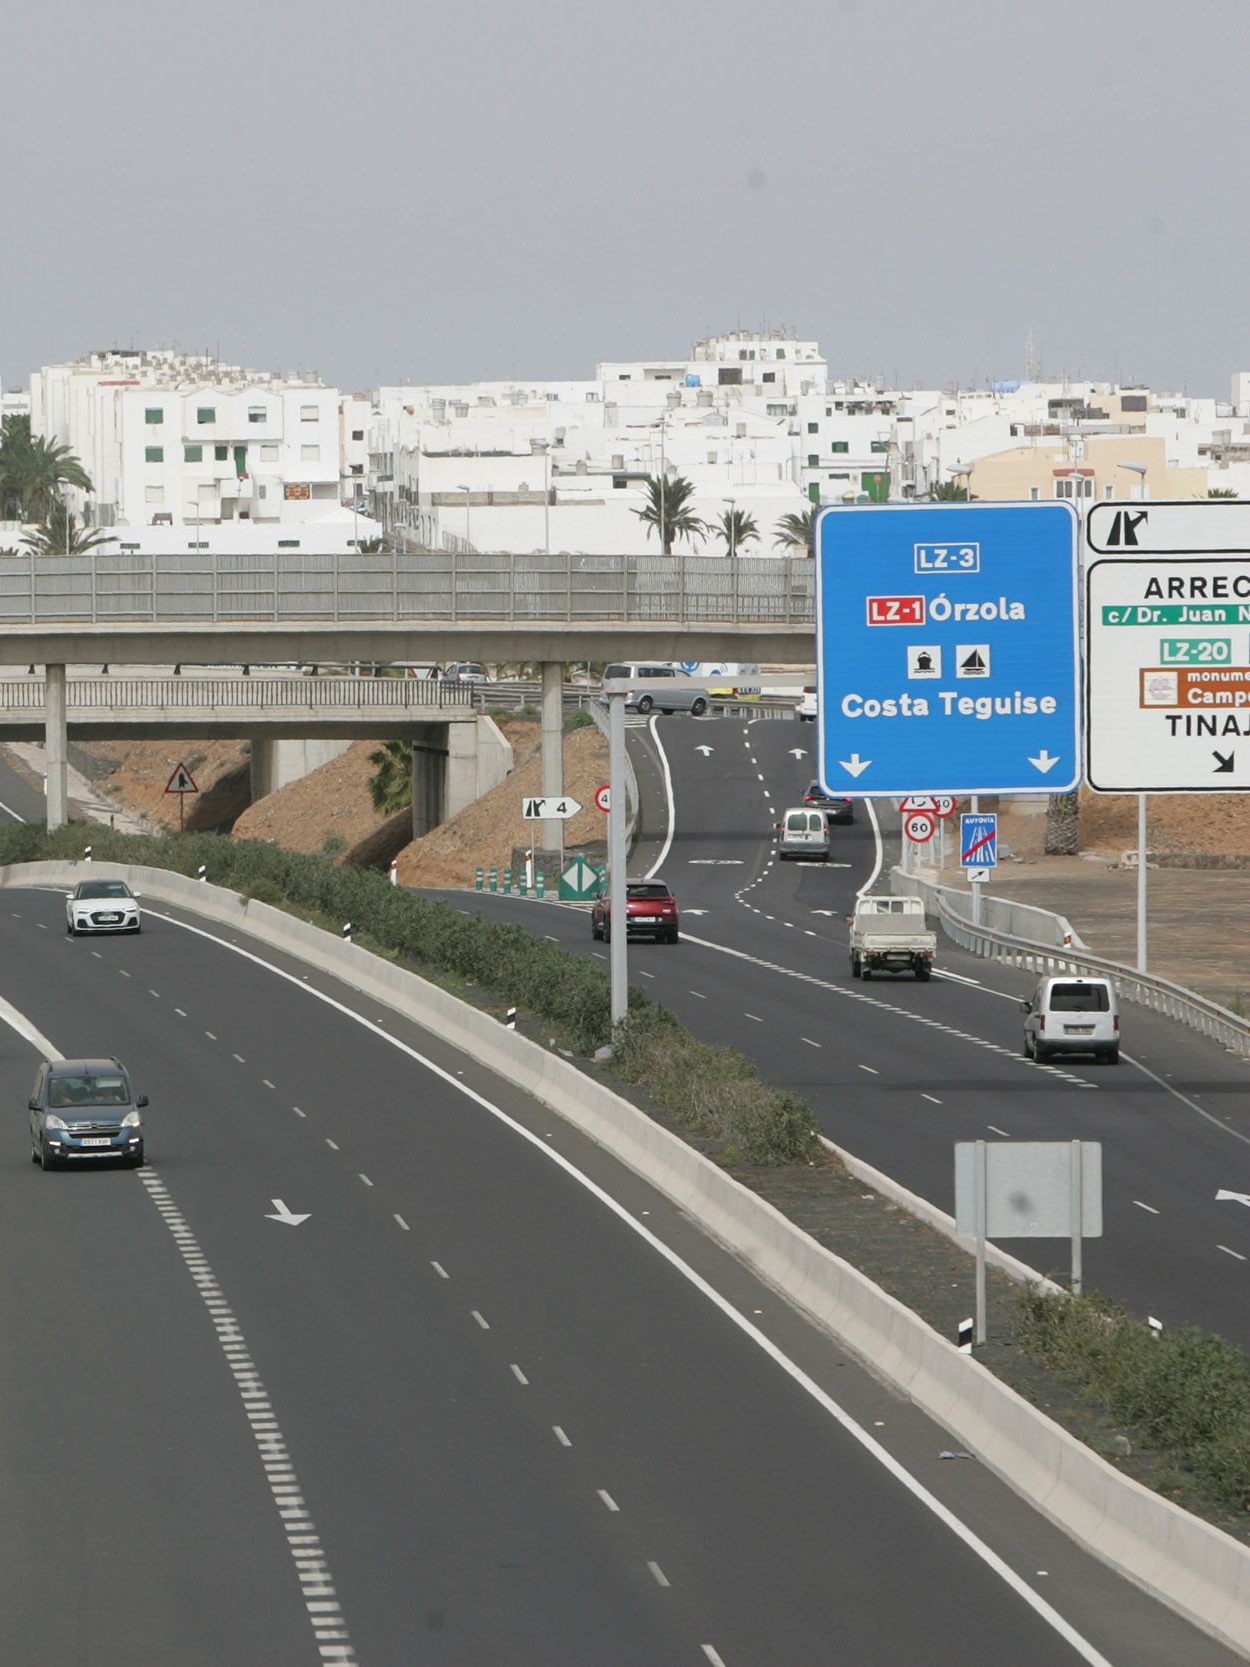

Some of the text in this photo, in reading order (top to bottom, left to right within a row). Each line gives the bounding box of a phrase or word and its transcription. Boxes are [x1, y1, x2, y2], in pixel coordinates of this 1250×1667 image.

[919, 548, 975, 568] LZ-3
[1143, 575, 1250, 599] ARREC
[871, 593, 1025, 621] LZ-1 Órzola
[1137, 606, 1167, 622] Dr.
[1178, 606, 1227, 622] Juan
[1162, 641, 1228, 661] LZ-20
[841, 691, 1057, 720] Costa Teguise
[556, 802, 567, 813] 4
[911, 823, 928, 832] 60
